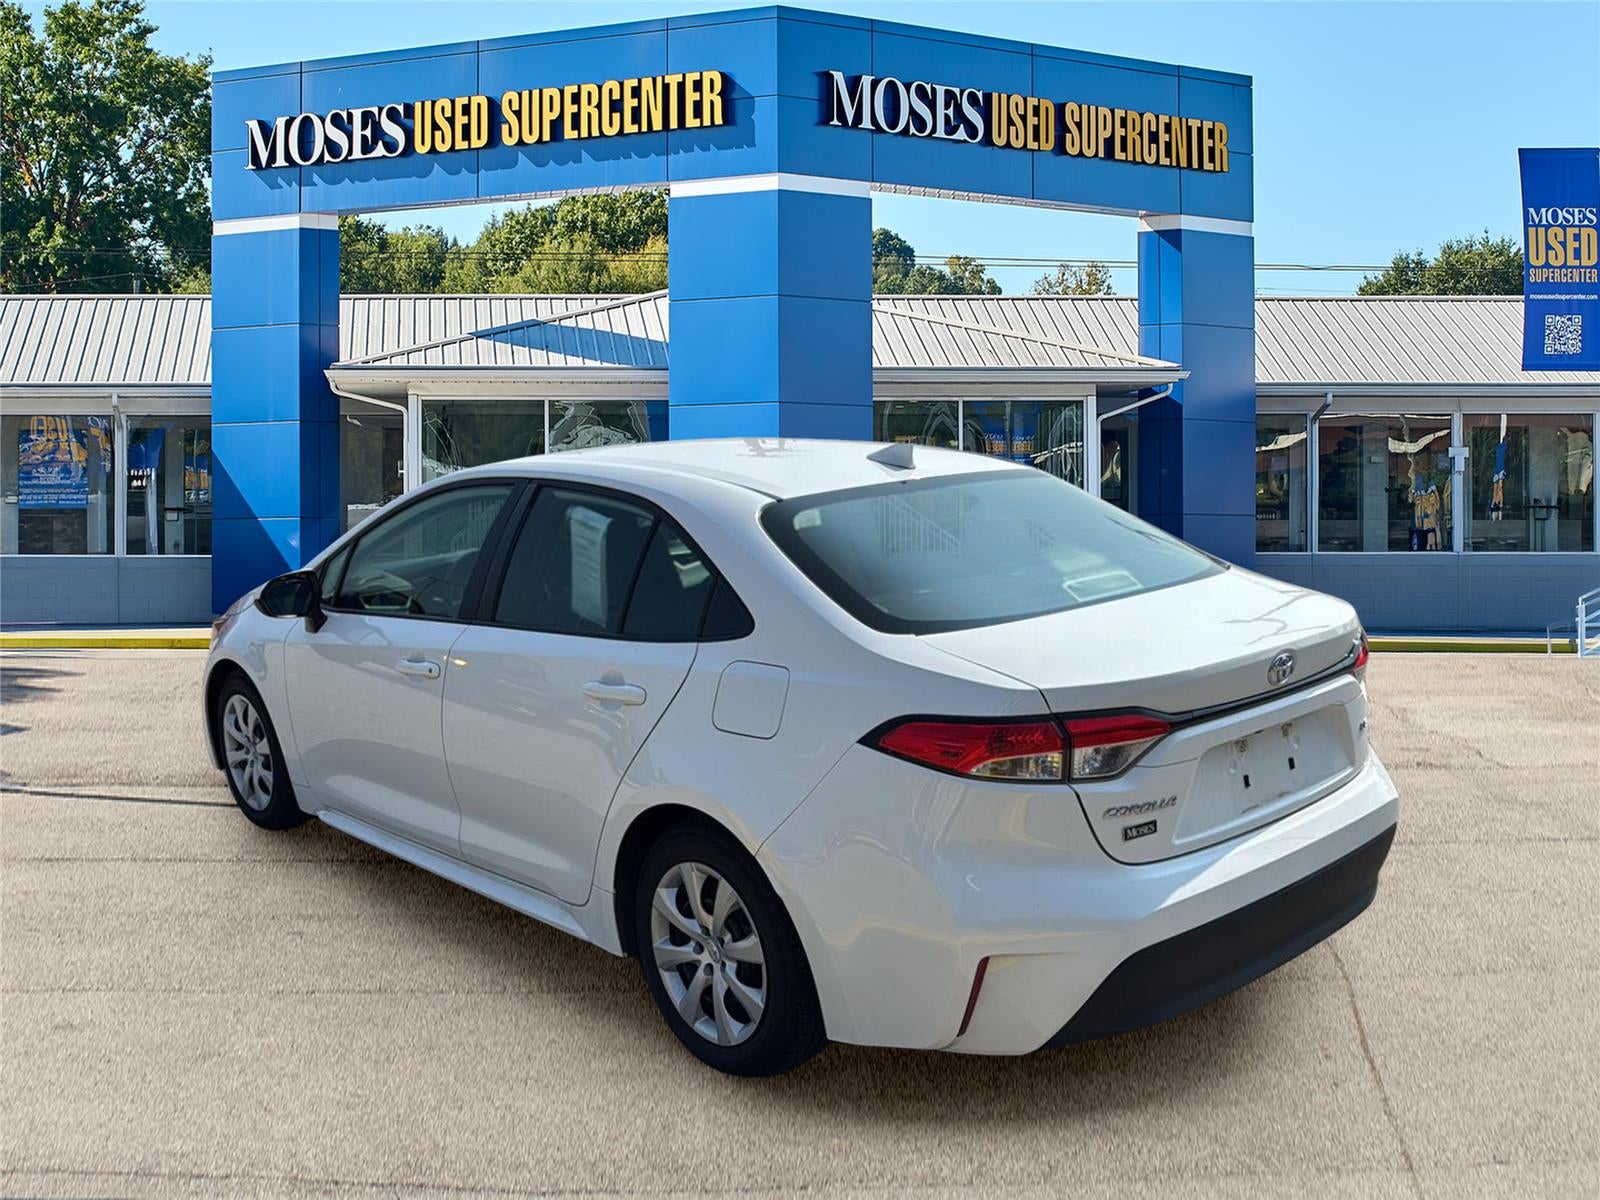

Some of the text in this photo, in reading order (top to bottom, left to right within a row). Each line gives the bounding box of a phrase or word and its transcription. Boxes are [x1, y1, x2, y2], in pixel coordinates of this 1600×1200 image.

[244, 70, 724, 170] MOSES USED SUPERCENTER
[828, 70, 1230, 173] MOSES USED SUPERCENTER
[1527, 207, 1597, 225] MOSES
[1528, 227, 1598, 266] USED
[1529, 268, 1598, 282] SUPERCENTER
[1103, 794, 1177, 817] COROLLA
